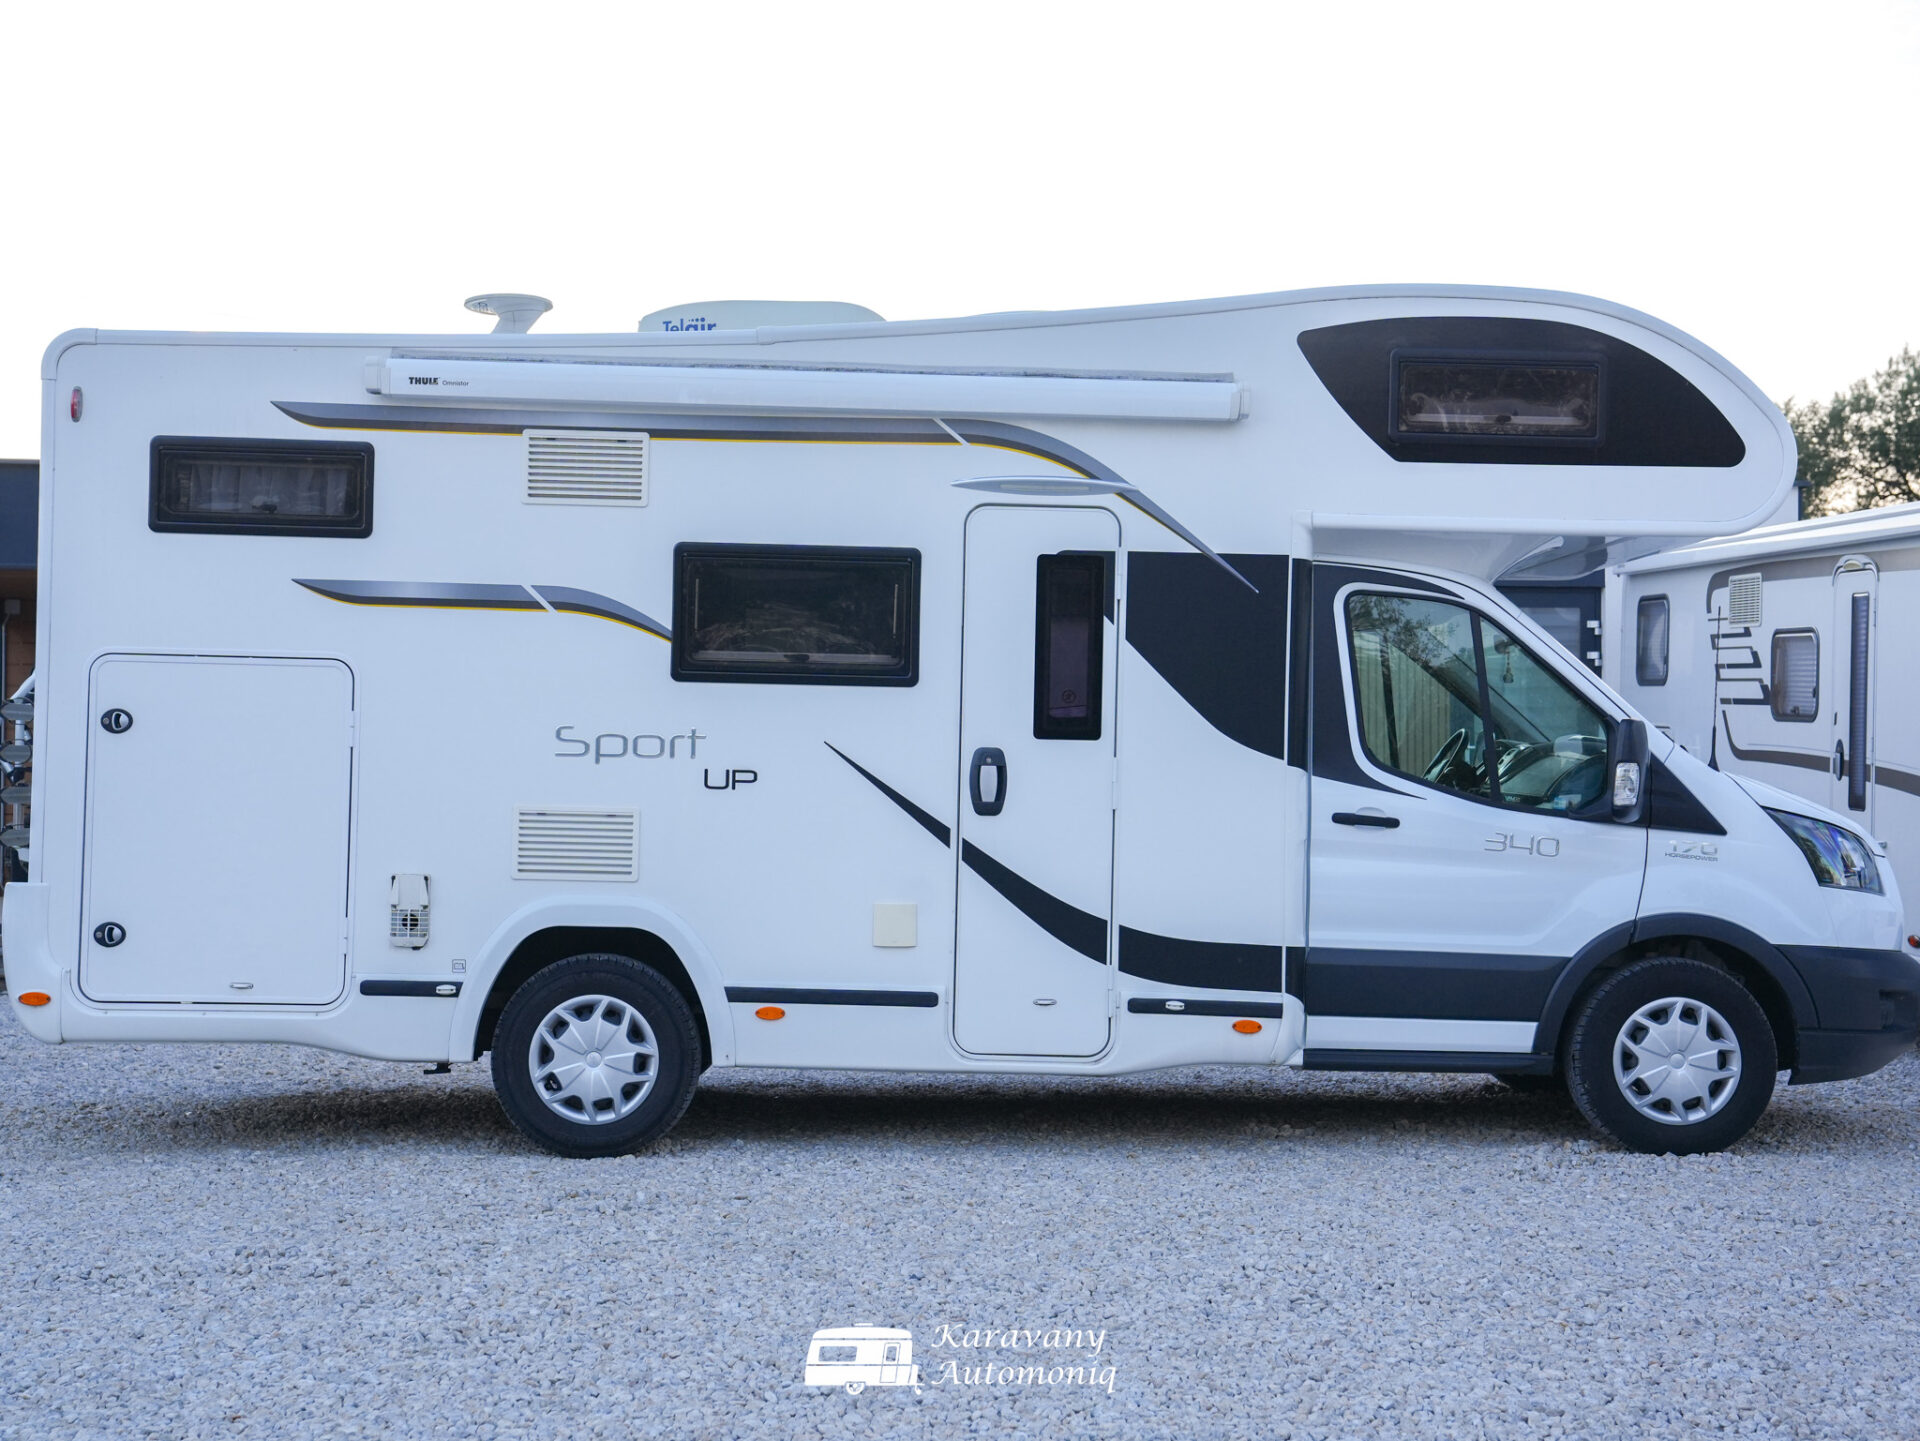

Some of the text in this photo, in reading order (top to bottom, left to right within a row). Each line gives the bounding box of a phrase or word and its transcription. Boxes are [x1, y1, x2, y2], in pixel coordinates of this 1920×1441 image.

[408, 376, 440, 385] THULE
[555, 726, 707, 764] Sport
[704, 768, 758, 790] UP
[1484, 832, 1560, 858] 340
[1669, 839, 1718, 856] 170
[1665, 851, 1719, 862] HORSEPOWER
